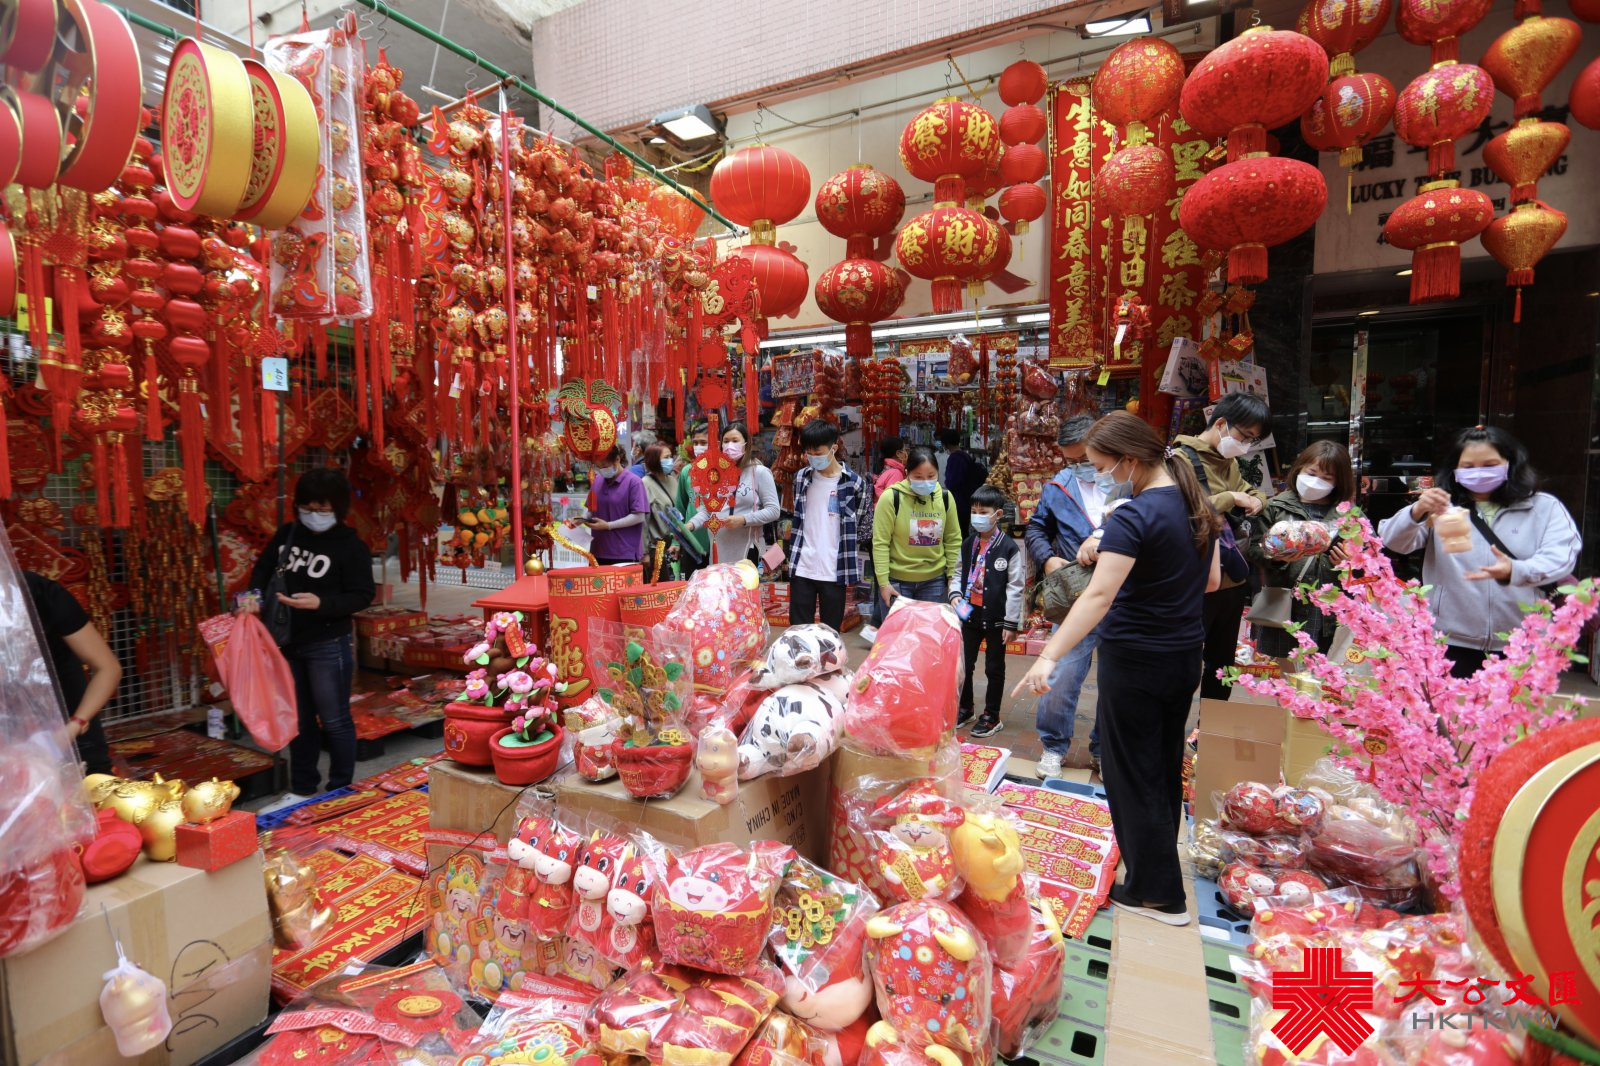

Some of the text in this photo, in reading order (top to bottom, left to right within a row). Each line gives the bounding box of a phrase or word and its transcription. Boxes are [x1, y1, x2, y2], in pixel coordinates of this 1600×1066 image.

[1056, 95, 1093, 334] 生意如同春意美
[1350, 178, 1404, 204] LUCKY
[746, 783, 801, 834] MADE IN CHINA
[303, 898, 425, 974] 吉星高照
